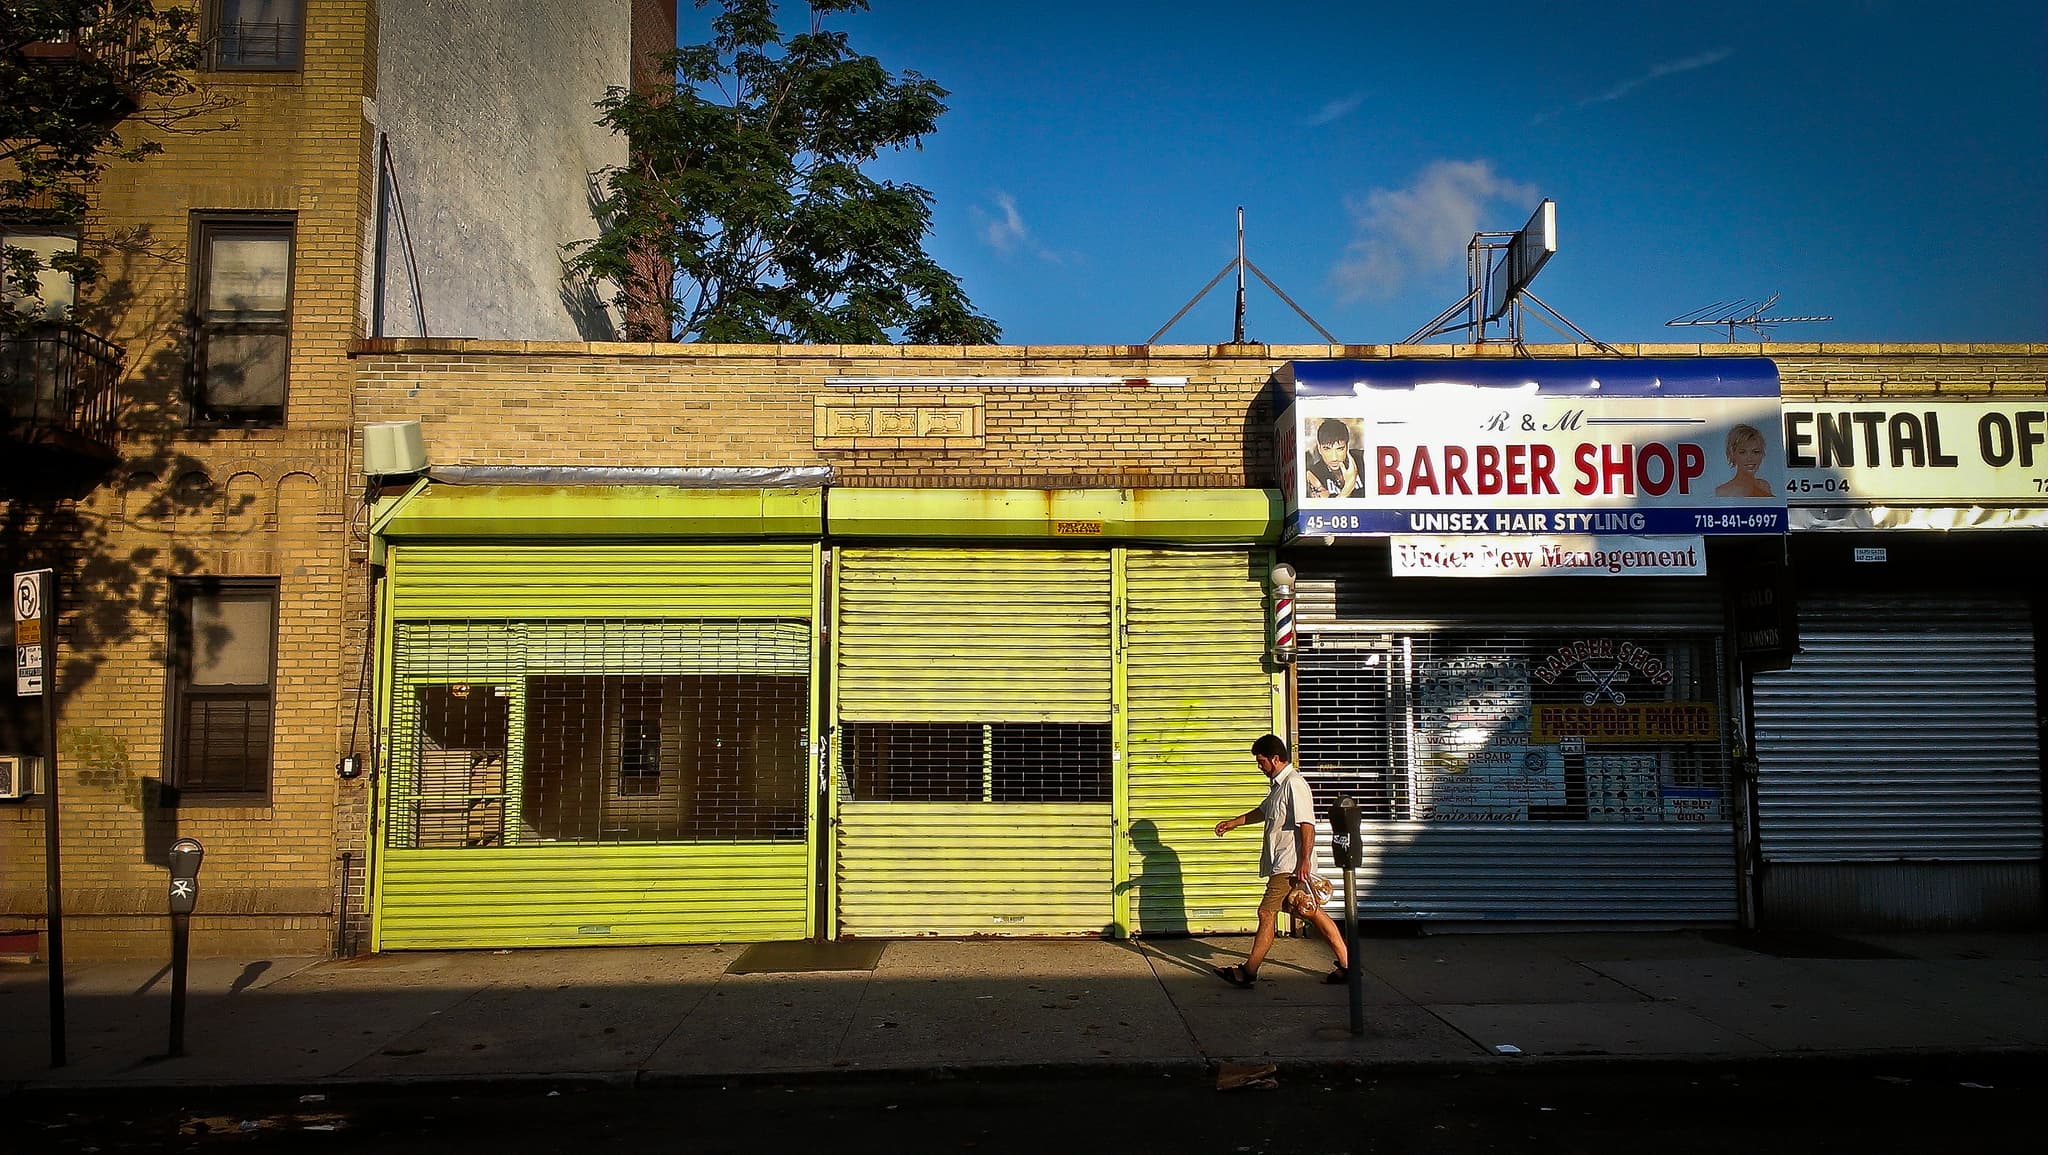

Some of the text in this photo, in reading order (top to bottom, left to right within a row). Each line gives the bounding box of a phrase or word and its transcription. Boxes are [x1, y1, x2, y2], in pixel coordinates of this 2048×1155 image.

[1521, 413, 1536, 432] &
[1542, 409, 1585, 432] M
[1978, 411, 2048, 468] OF
[1376, 442, 1706, 497] BARBER SHOP
[1786, 478, 1851, 493] 45-04
[1306, 515, 1360, 529] 45-08 B
[1410, 513, 1646, 531] UNISEX HAIR STYLING
[1694, 513, 1778, 529] 718-841-6997
[1398, 544, 1698, 574] Under New Management
[1534, 639, 1674, 686] BARBER SHOP
[1541, 707, 1711, 736] PASSPORT PHOTO
[1467, 751, 1512, 764] REPAIR
